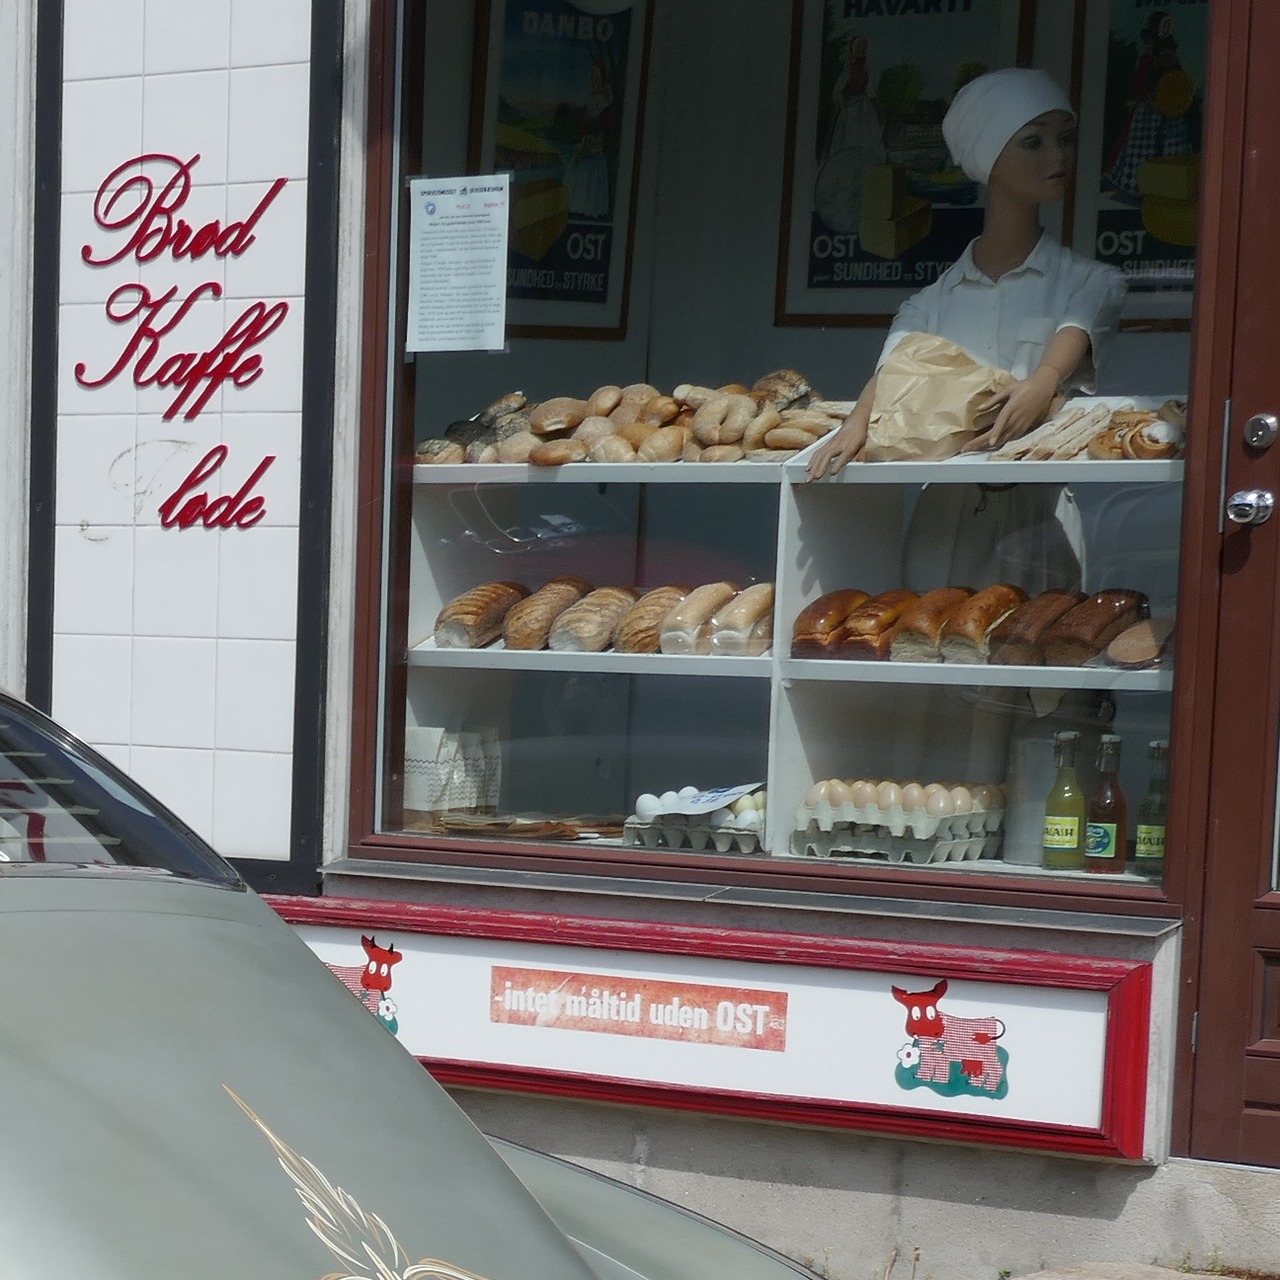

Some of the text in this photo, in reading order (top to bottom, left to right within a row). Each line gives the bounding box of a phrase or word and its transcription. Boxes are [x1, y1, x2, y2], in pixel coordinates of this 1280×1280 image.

[567, 232, 606, 261] OST
[813, 234, 859, 259] OST
[1097, 230, 1147, 256] OST
[833, 261, 902, 281] SUNDHED
[75, 282, 290, 422] Kaffe
[565, 986, 642, 1023] måltid
[649, 997, 709, 1029] uden
[715, 1000, 770, 1035] OST
